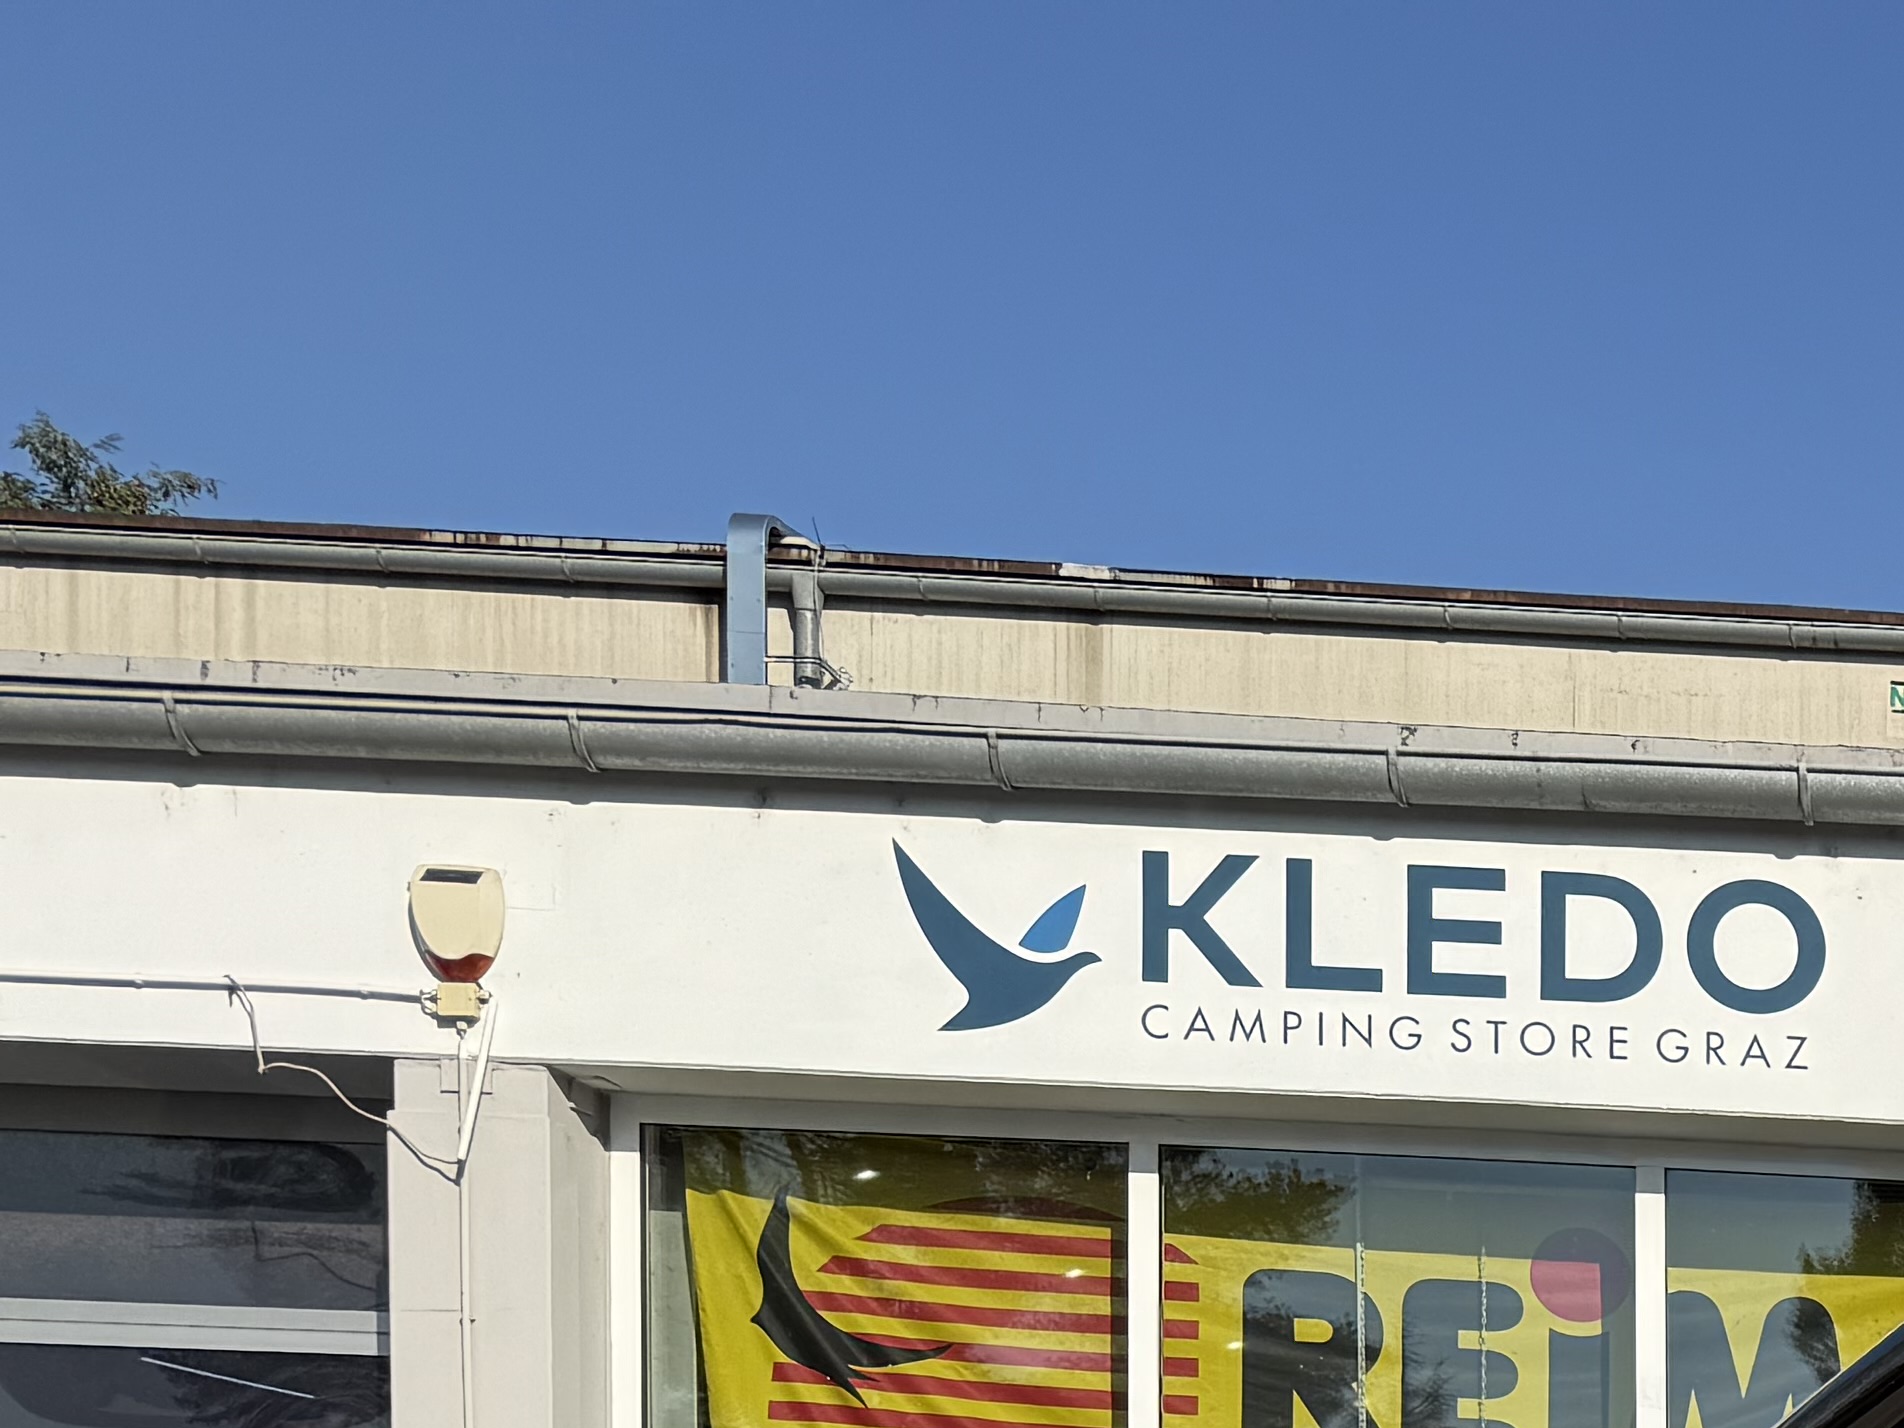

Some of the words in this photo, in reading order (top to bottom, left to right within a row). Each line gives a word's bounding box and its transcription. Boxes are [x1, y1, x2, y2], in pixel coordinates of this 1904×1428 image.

[1141, 850, 1827, 1015] KLEDO
[1140, 1003, 1424, 1052] CAMPING
[1450, 1018, 1630, 1061] STORE
[1655, 1028, 1810, 1071] GRAZ
